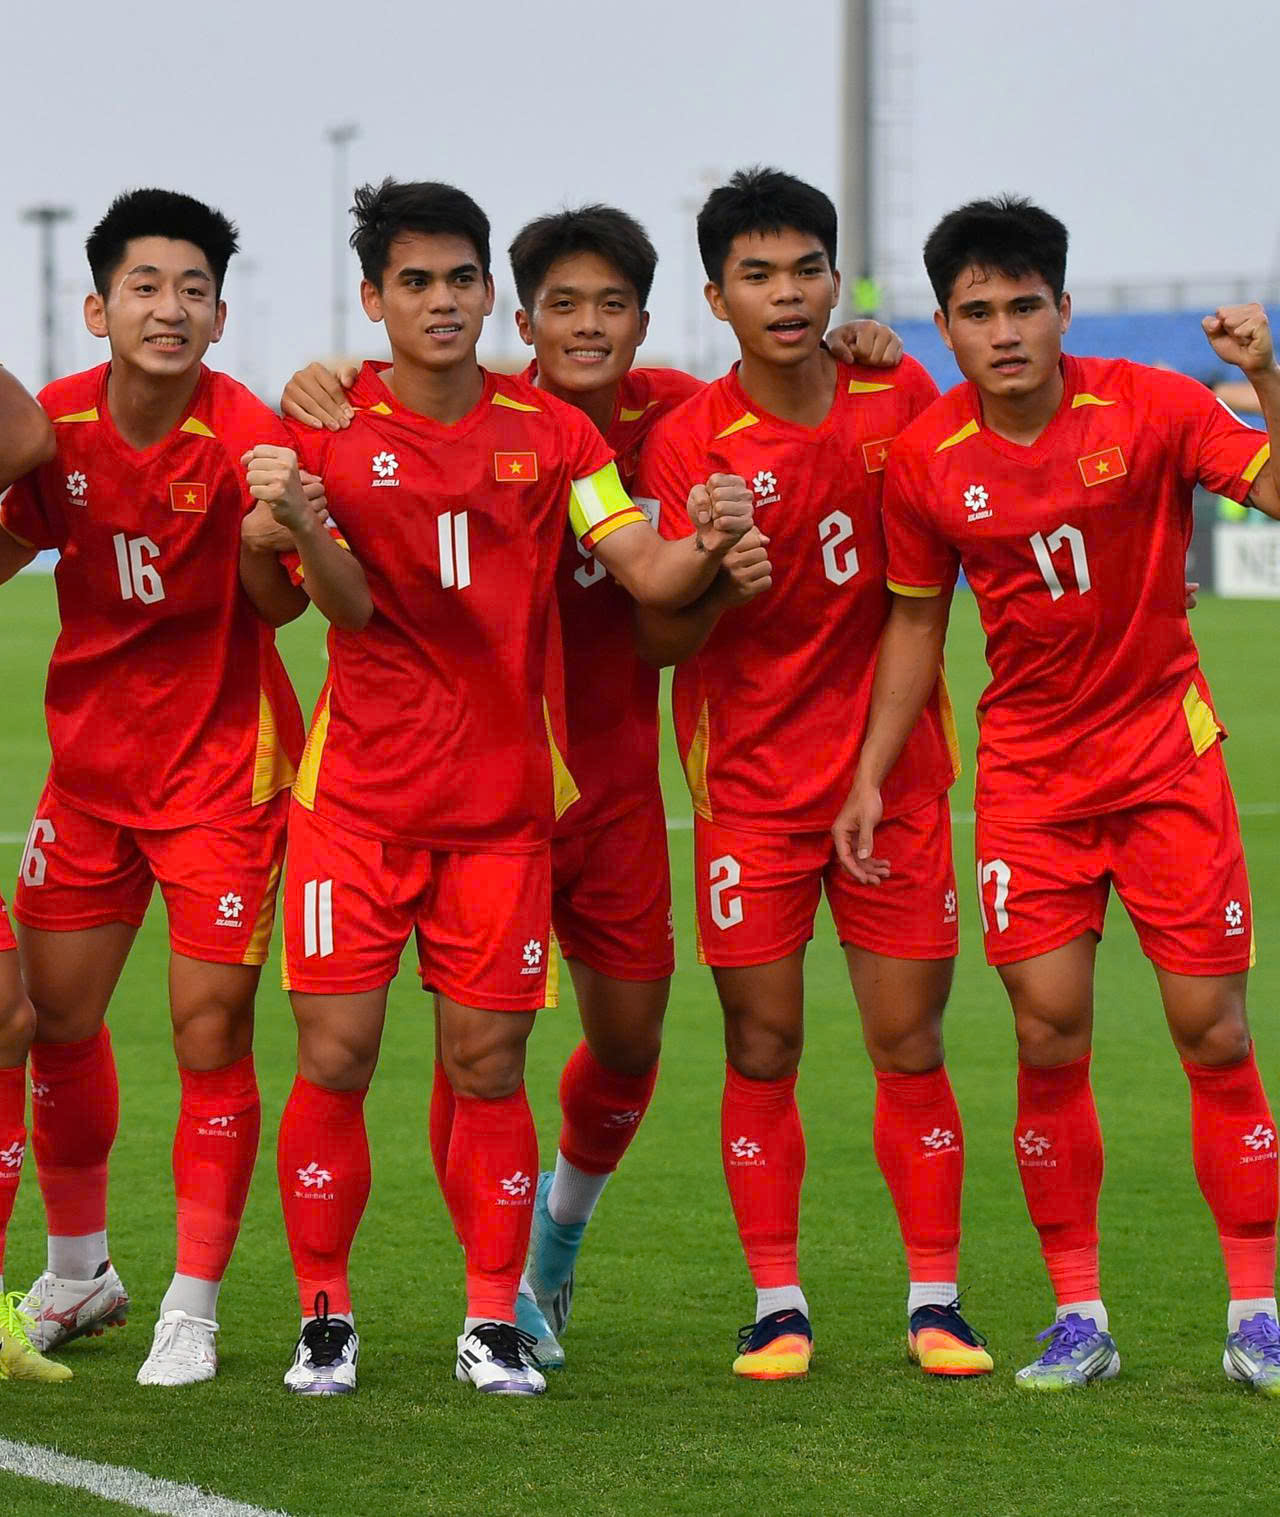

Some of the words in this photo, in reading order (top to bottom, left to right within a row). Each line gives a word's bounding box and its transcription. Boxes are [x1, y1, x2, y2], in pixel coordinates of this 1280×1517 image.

[114, 534, 164, 604] 16
[438, 512, 470, 589] 11
[819, 511, 859, 585] 2
[1030, 524, 1090, 601] 17
[304, 880, 333, 957] 11
[710, 855, 743, 930] 2
